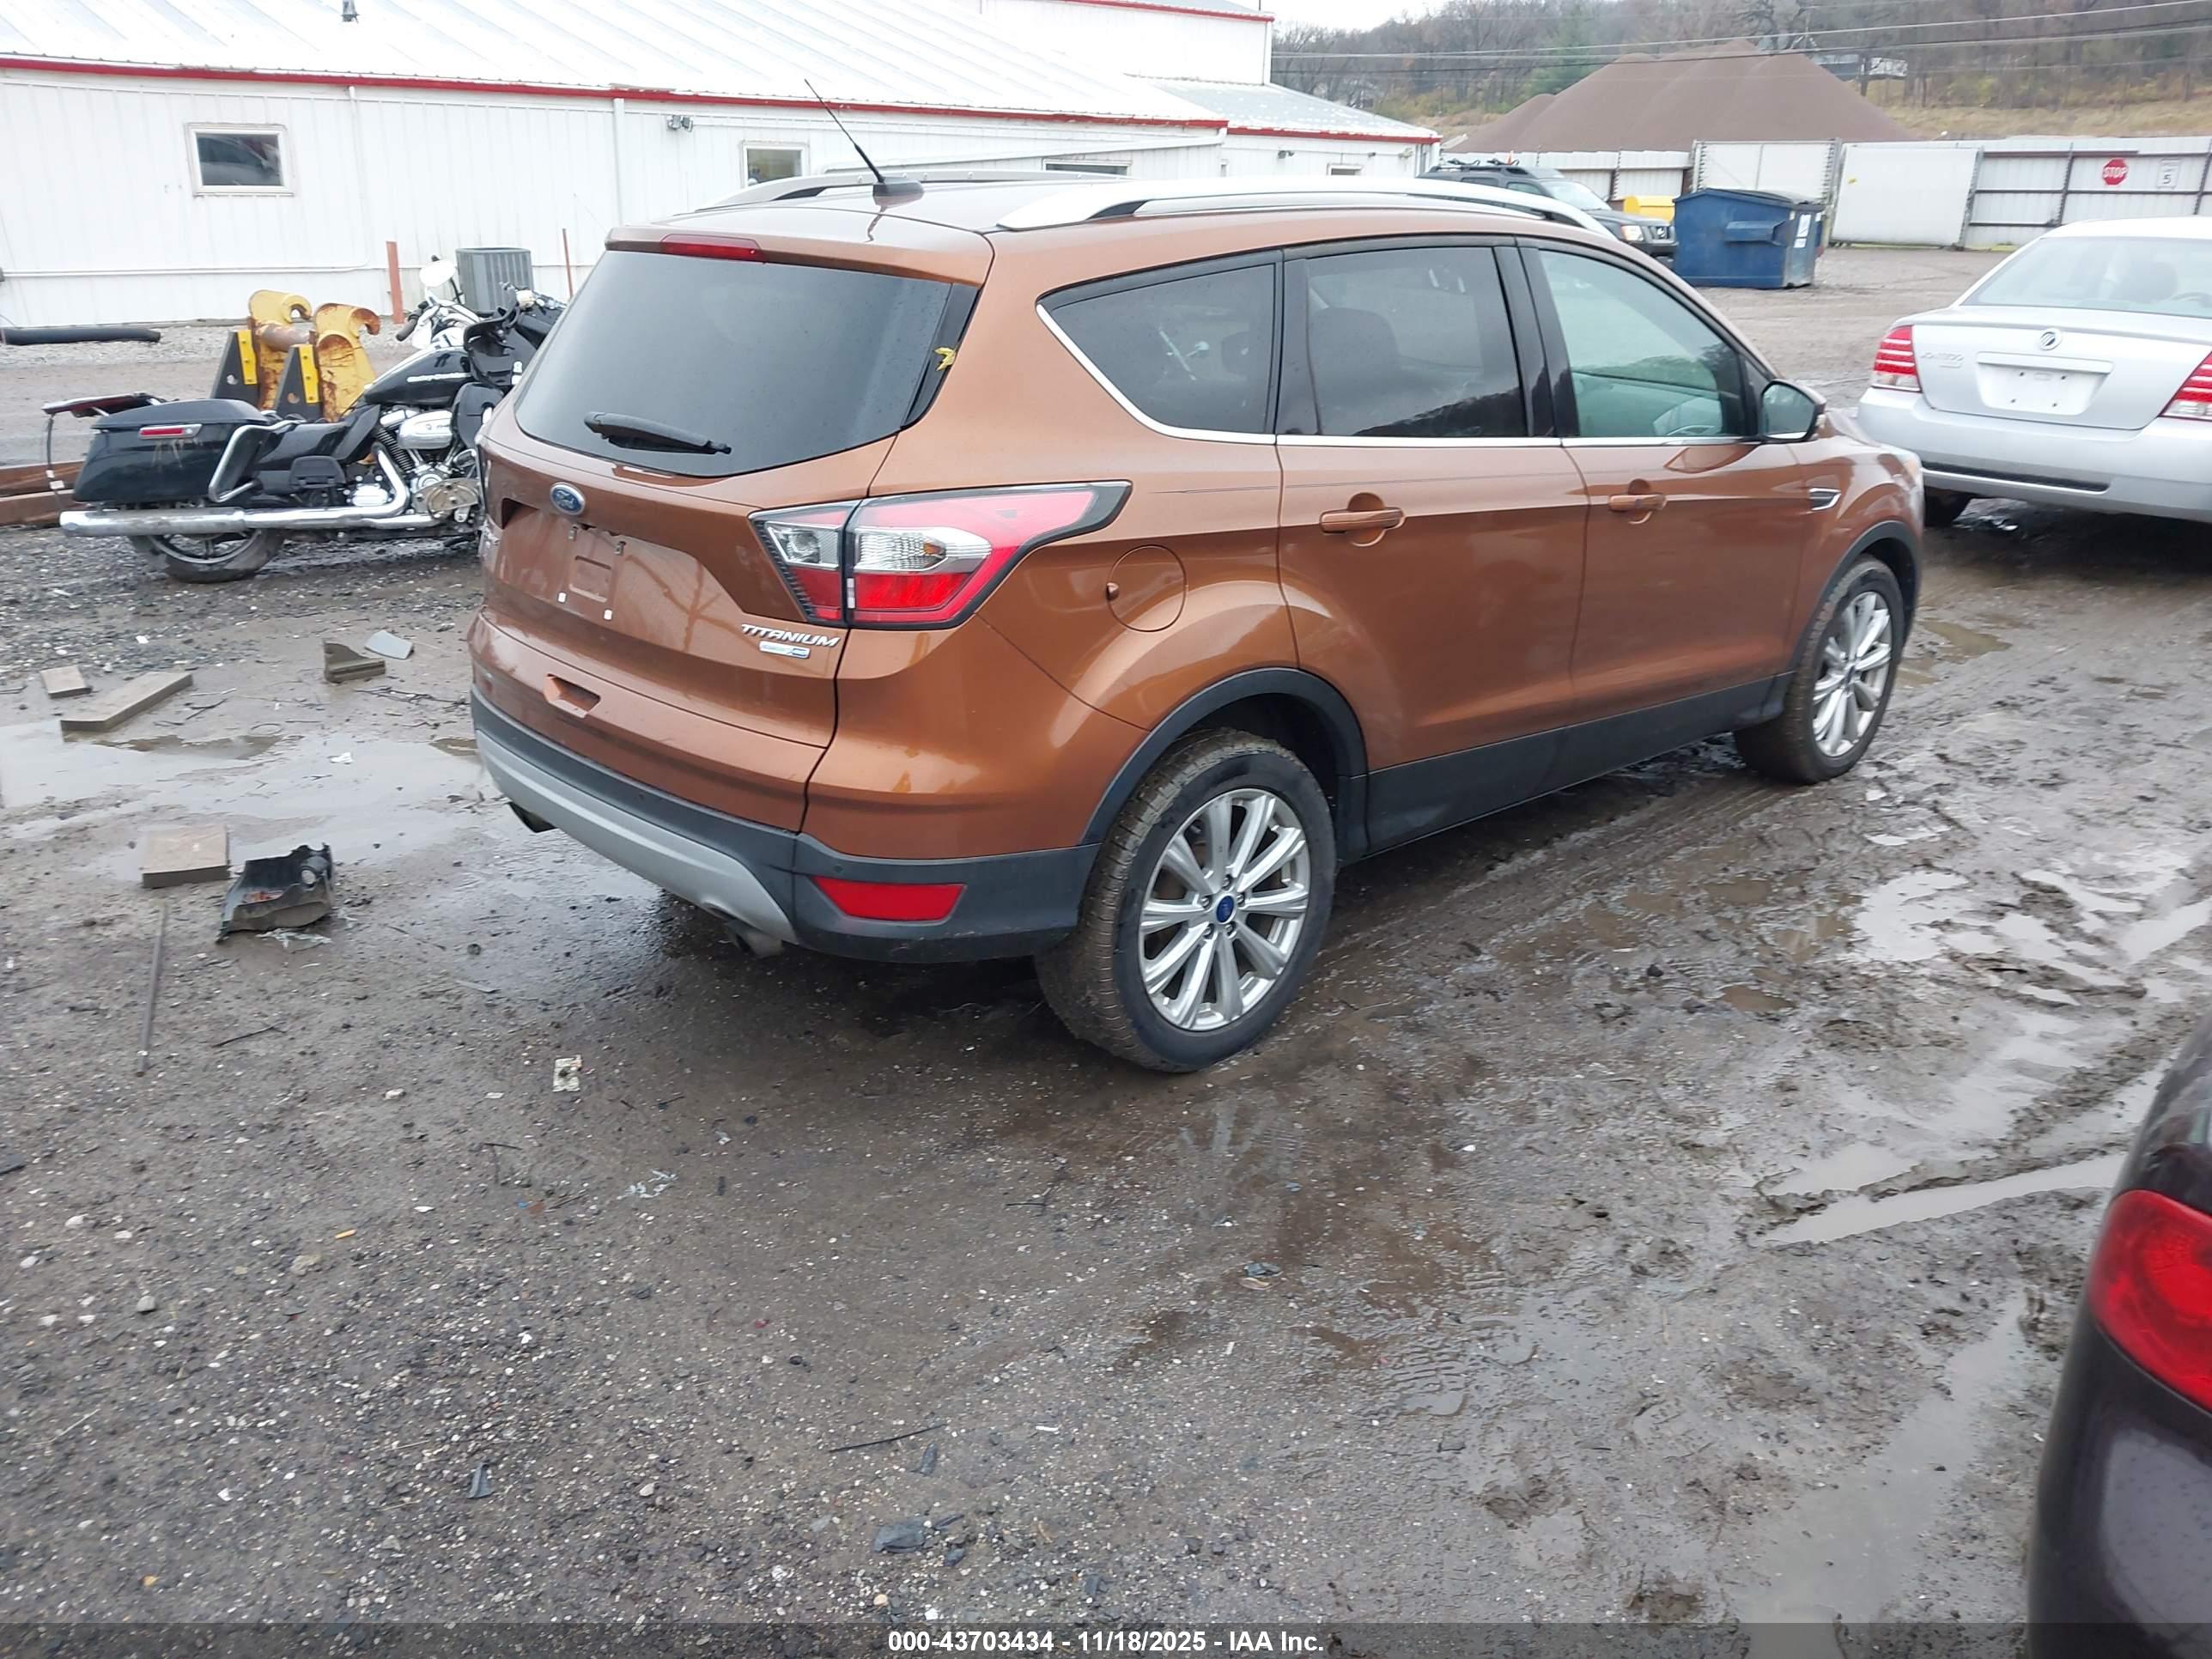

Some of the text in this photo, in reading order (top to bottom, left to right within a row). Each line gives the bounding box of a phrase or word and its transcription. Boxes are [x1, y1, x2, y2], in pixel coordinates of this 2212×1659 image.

[2103, 166, 2129, 179] STOP
[2162, 173, 2172, 185] 5
[740, 623, 841, 647] TITANIUM
